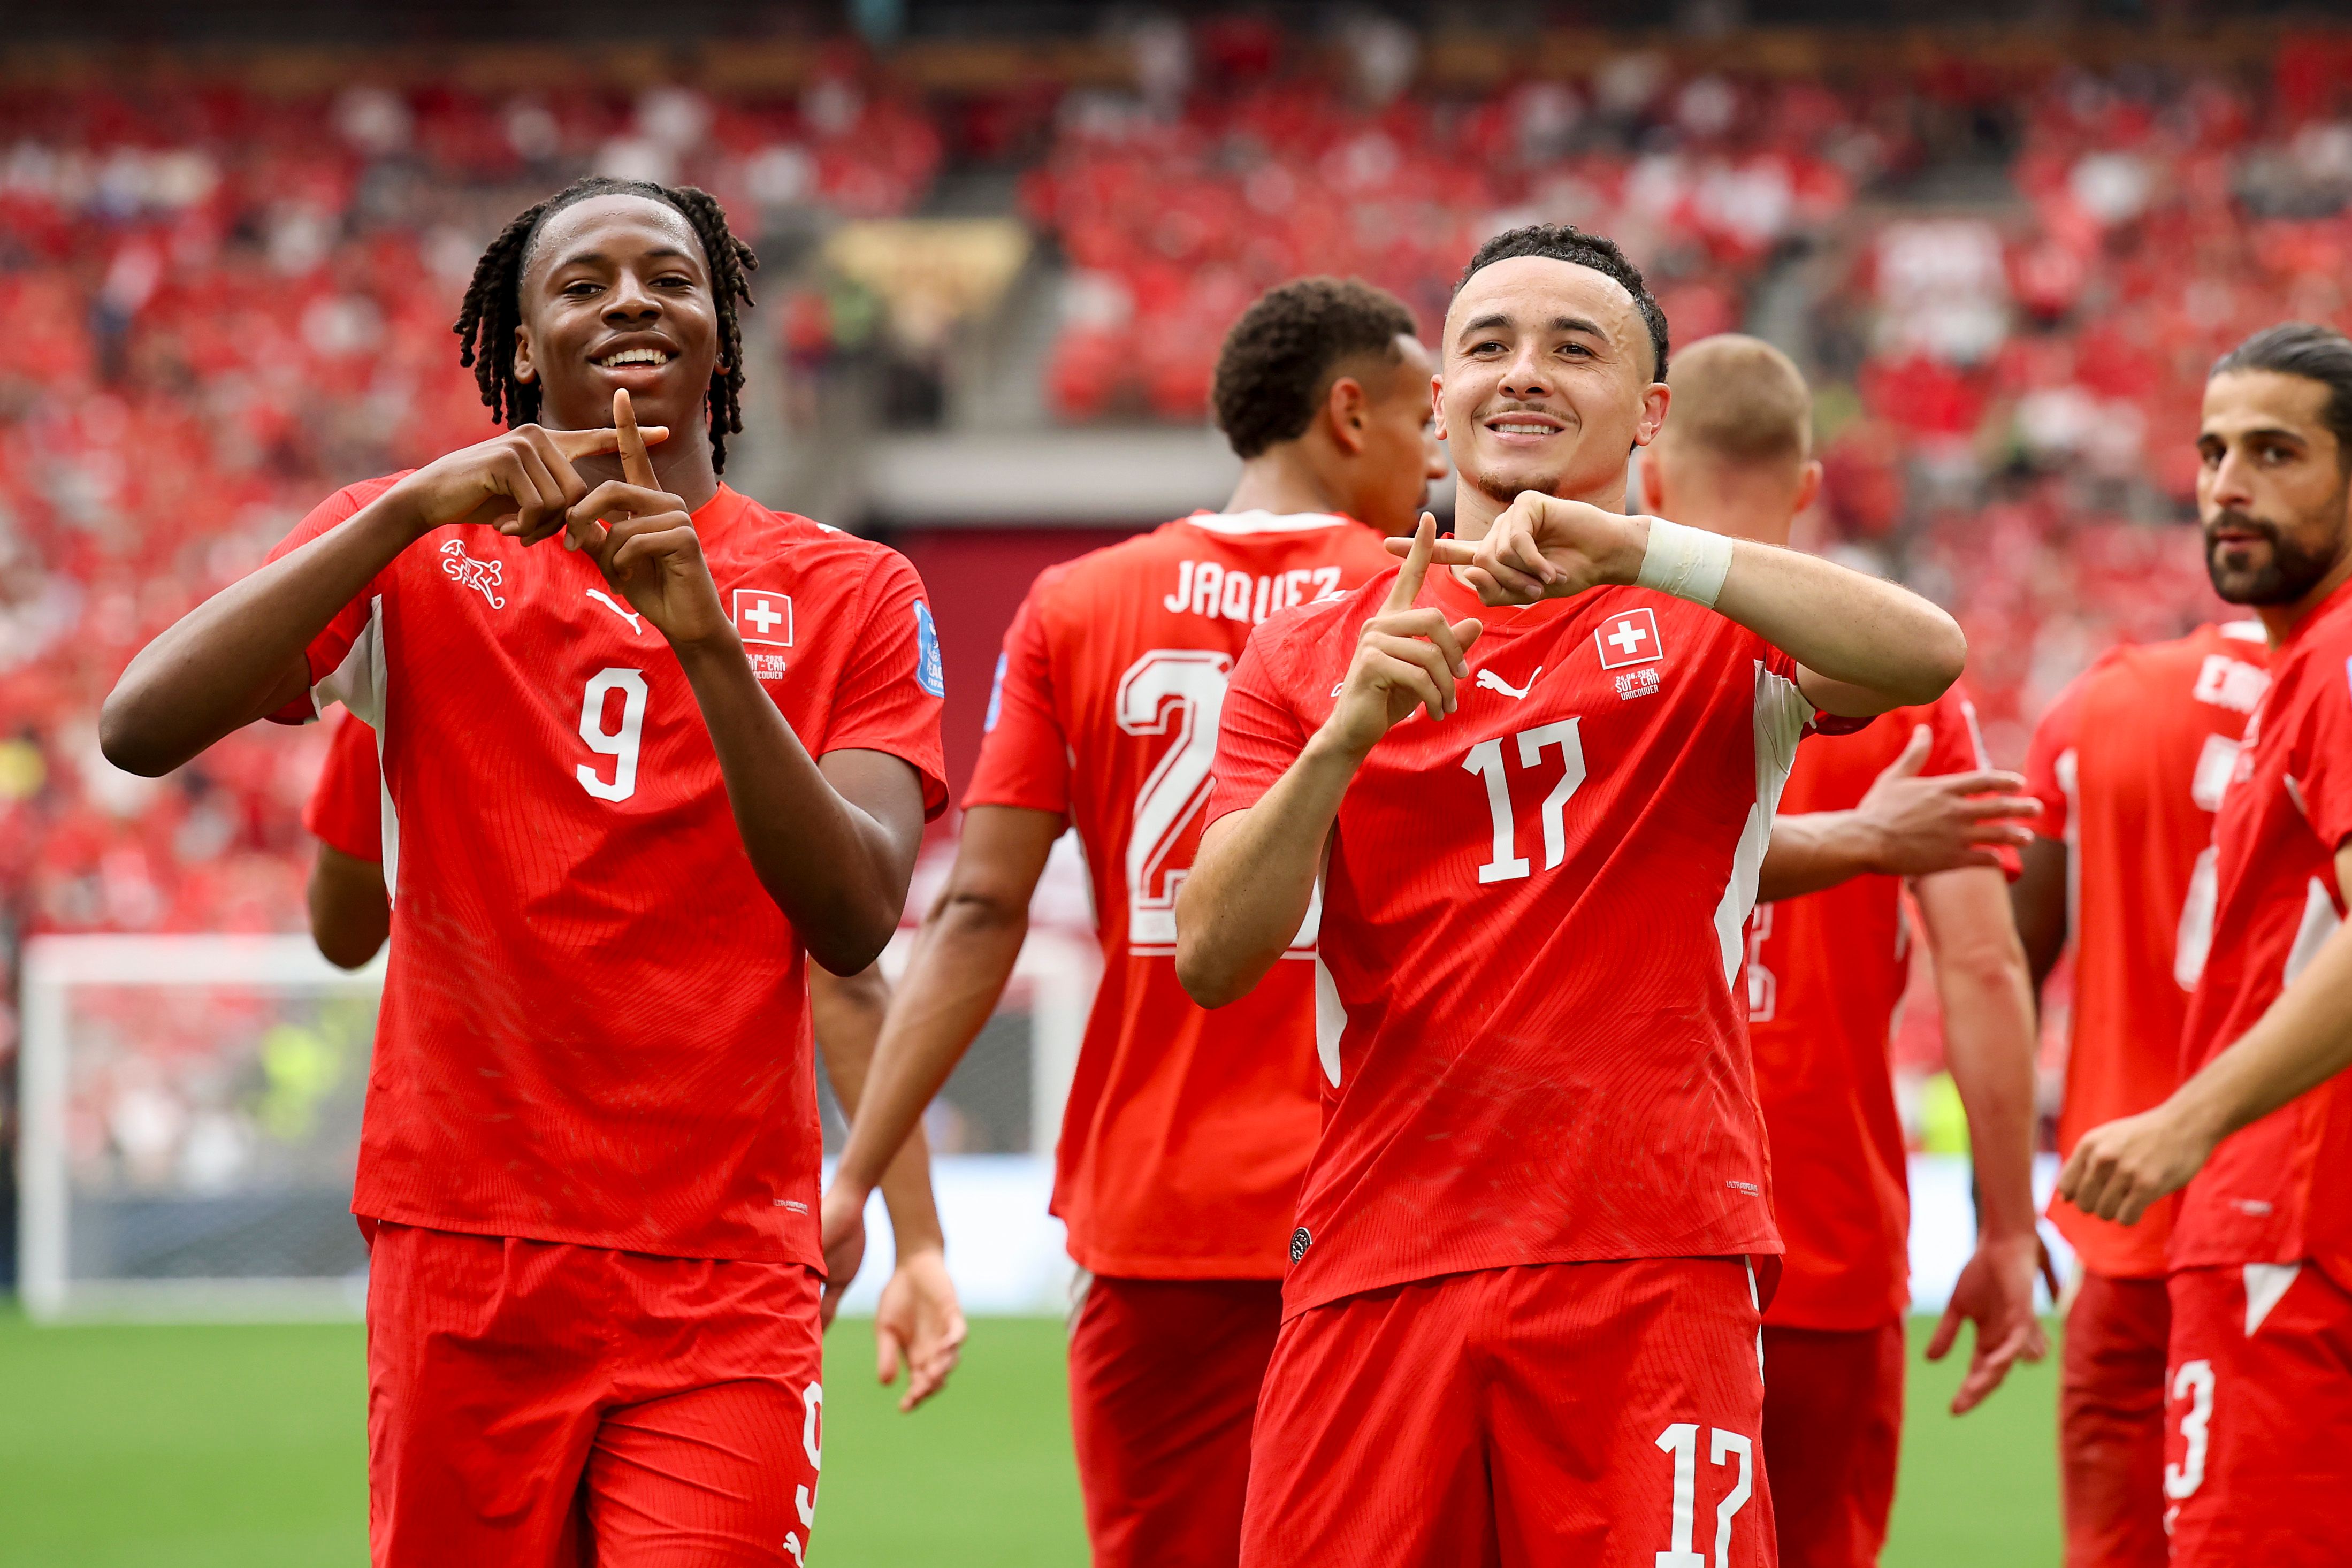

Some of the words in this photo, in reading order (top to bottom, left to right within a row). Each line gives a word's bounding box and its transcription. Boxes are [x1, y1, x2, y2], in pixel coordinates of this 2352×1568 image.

[1164, 560, 1342, 625] JAQUEZ
[753, 671, 783, 680] NCOUVER
[767, 661, 786, 671] CAN
[1616, 668, 1654, 684] 24.06.2026
[1615, 680, 1632, 693] SUI
[1640, 672, 1660, 686] CAN
[1620, 684, 1659, 701] VANCOUVER
[576, 667, 648, 803] 9
[1461, 716, 1587, 884] 17
[1654, 1423, 1753, 1568] 17
